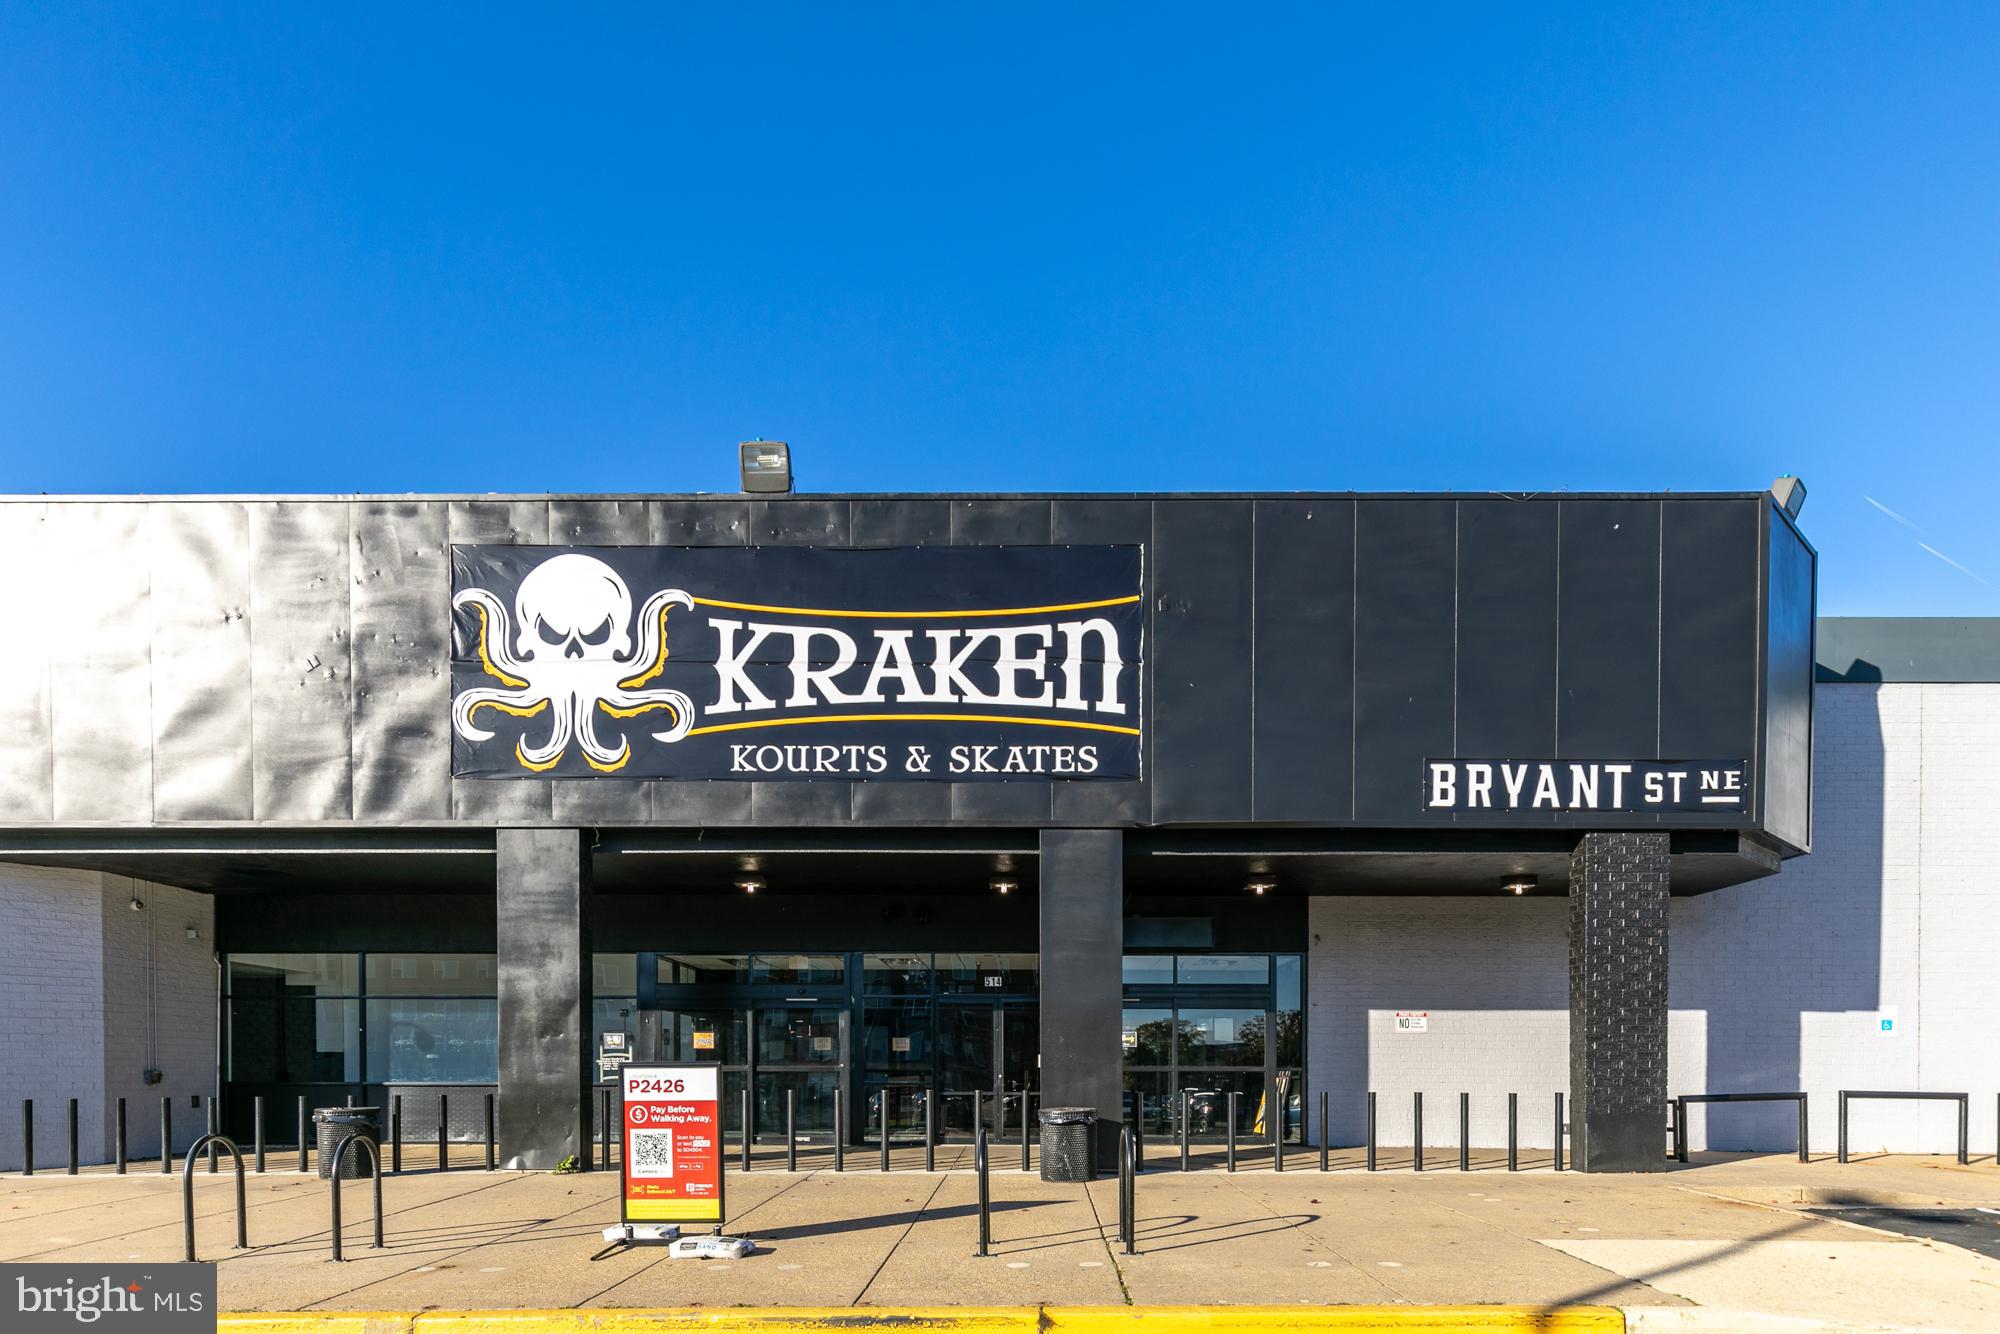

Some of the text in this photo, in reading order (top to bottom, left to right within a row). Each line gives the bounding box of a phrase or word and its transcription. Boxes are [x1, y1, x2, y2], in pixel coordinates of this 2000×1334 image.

[704, 617, 1126, 715] KRAKEN
[730, 744, 1099, 774] KOURTS & SKATES
[1429, 763, 1741, 808] BRYANT ST NE
[985, 977, 1002, 986] 514
[1399, 1018, 1410, 1029] NO
[629, 1079, 685, 1093] P2426
[650, 1105, 696, 1114] Pay Before
[650, 1114, 712, 1123] Walking Away.
